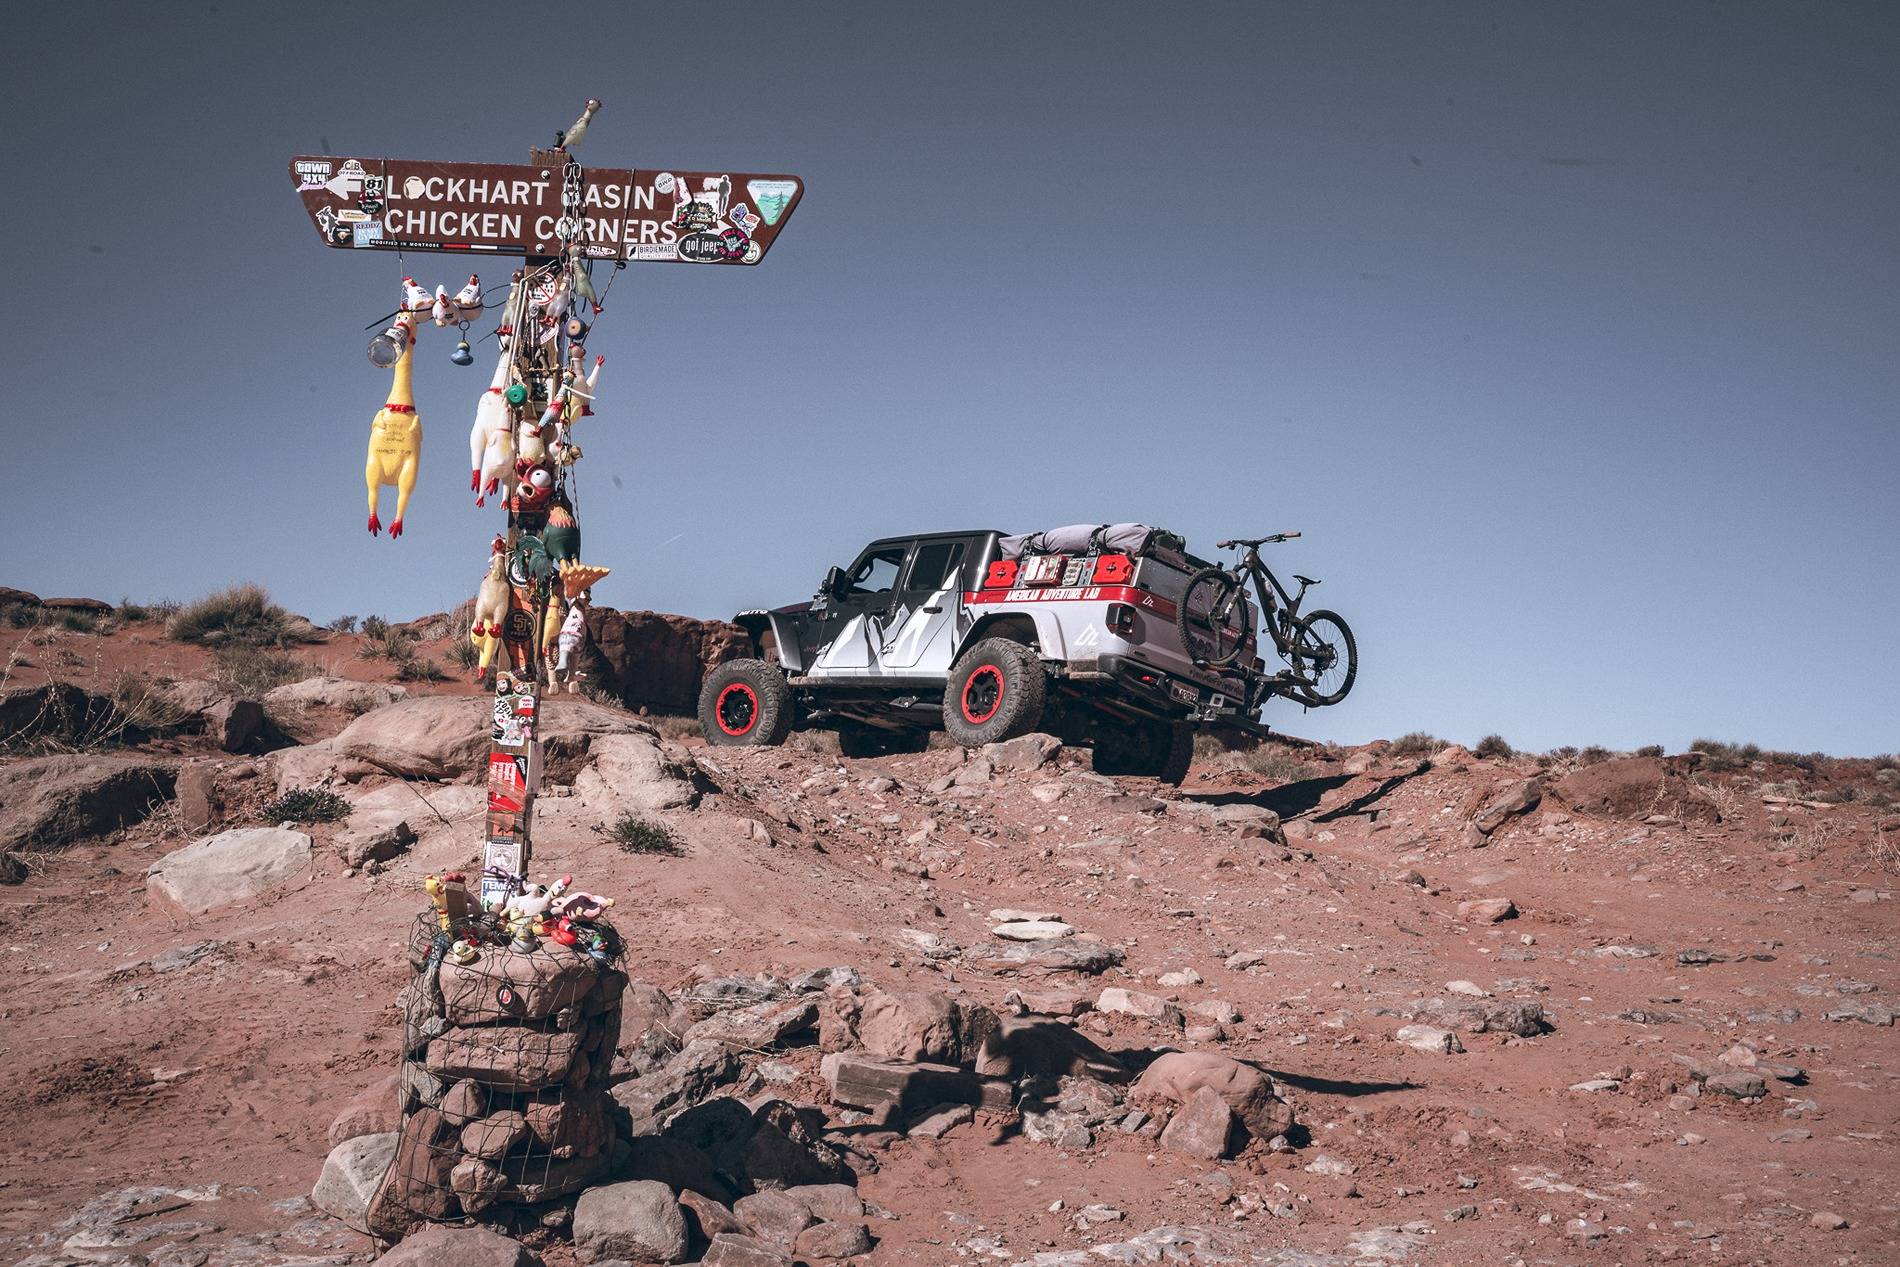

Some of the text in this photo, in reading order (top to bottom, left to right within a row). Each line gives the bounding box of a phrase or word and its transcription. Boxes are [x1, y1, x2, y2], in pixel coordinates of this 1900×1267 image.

[366, 179, 383, 189] 81
[387, 175, 655, 210] LOCKHART ASIN
[384, 209, 522, 239] CHICKEN
[685, 239, 699, 252] got
[1004, 587, 1101, 602] AMERICAN ADVENTURE LAB
